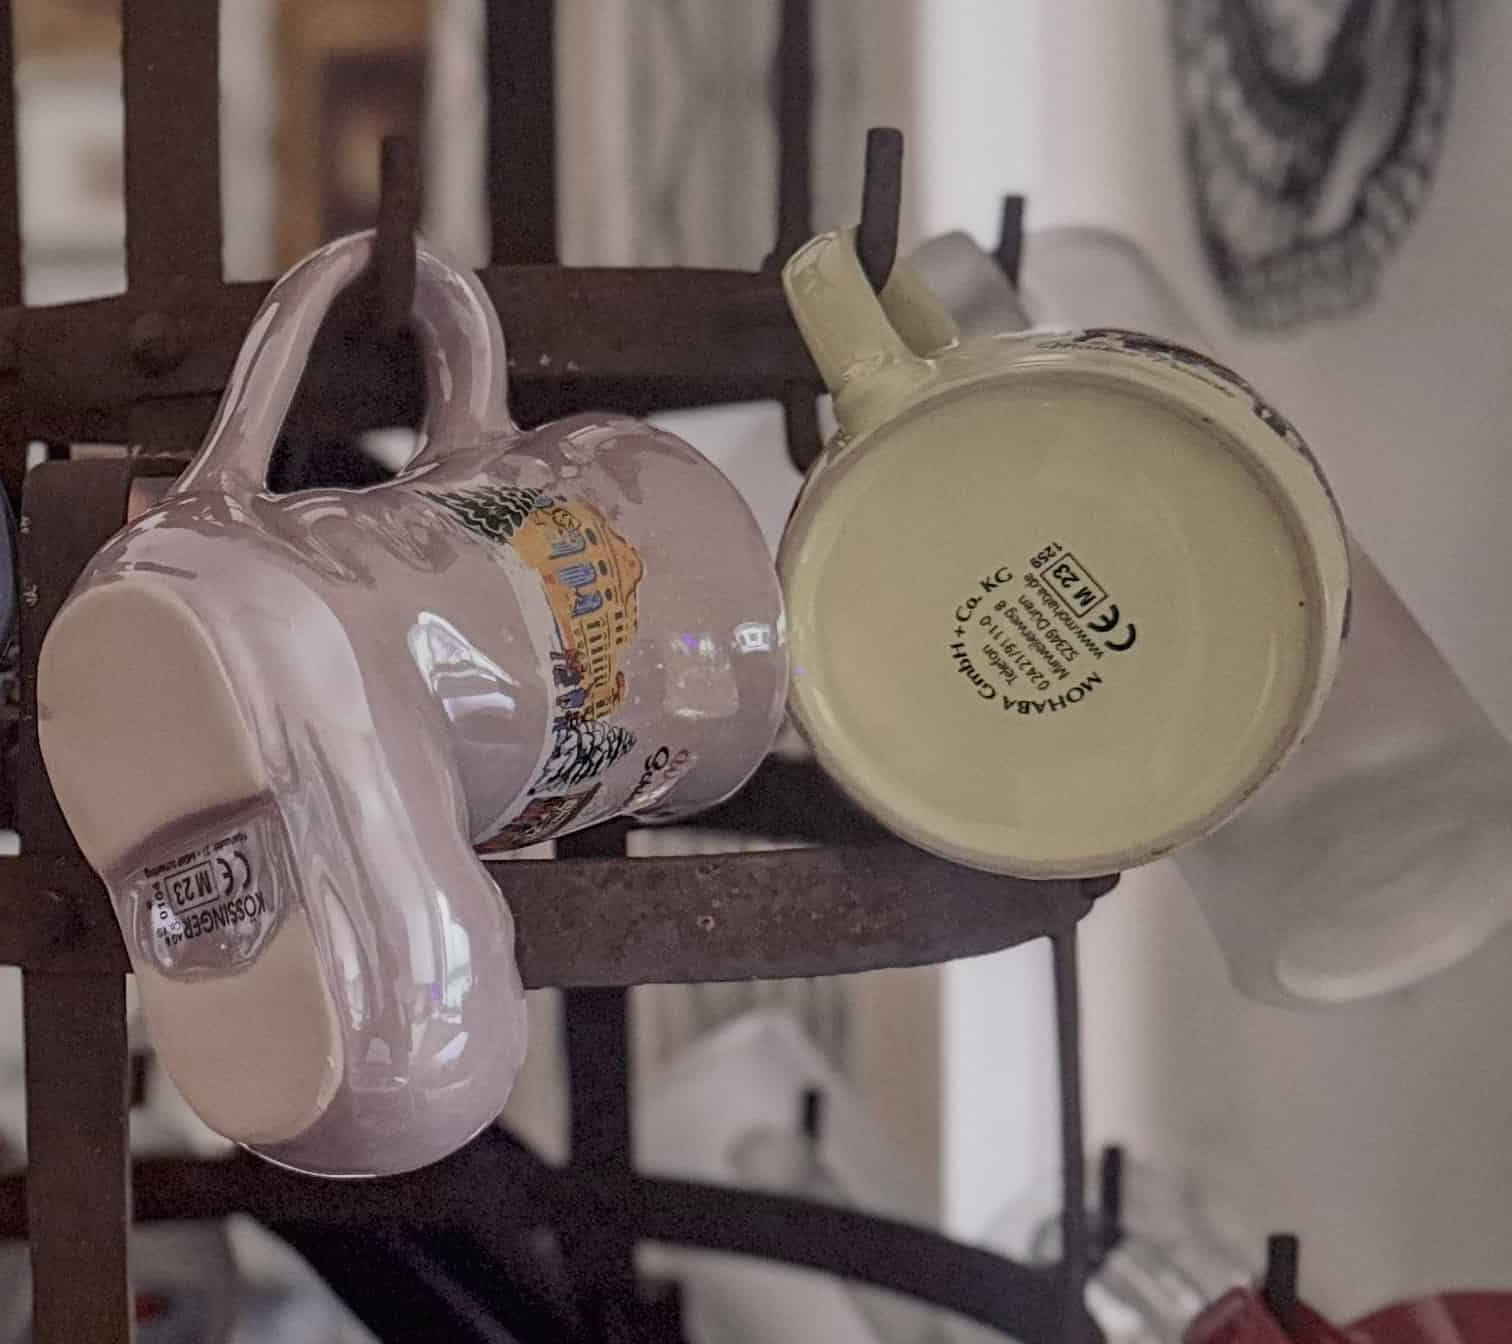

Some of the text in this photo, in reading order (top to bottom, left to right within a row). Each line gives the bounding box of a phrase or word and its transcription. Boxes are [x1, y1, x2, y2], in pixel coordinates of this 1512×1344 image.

[1052, 563, 1081, 588] 23
[1073, 585, 1097, 607] M
[1024, 572, 1105, 661] www.mohaba.de
[1044, 629, 1081, 662] 52349
[950, 642, 996, 700] GmbH
[982, 644, 1018, 686] Telefon
[1003, 671, 1103, 715] MOHABA
[173, 877, 194, 905] 23
[195, 869, 213, 897] M
[182, 890, 266, 939] KÖSSINGER
